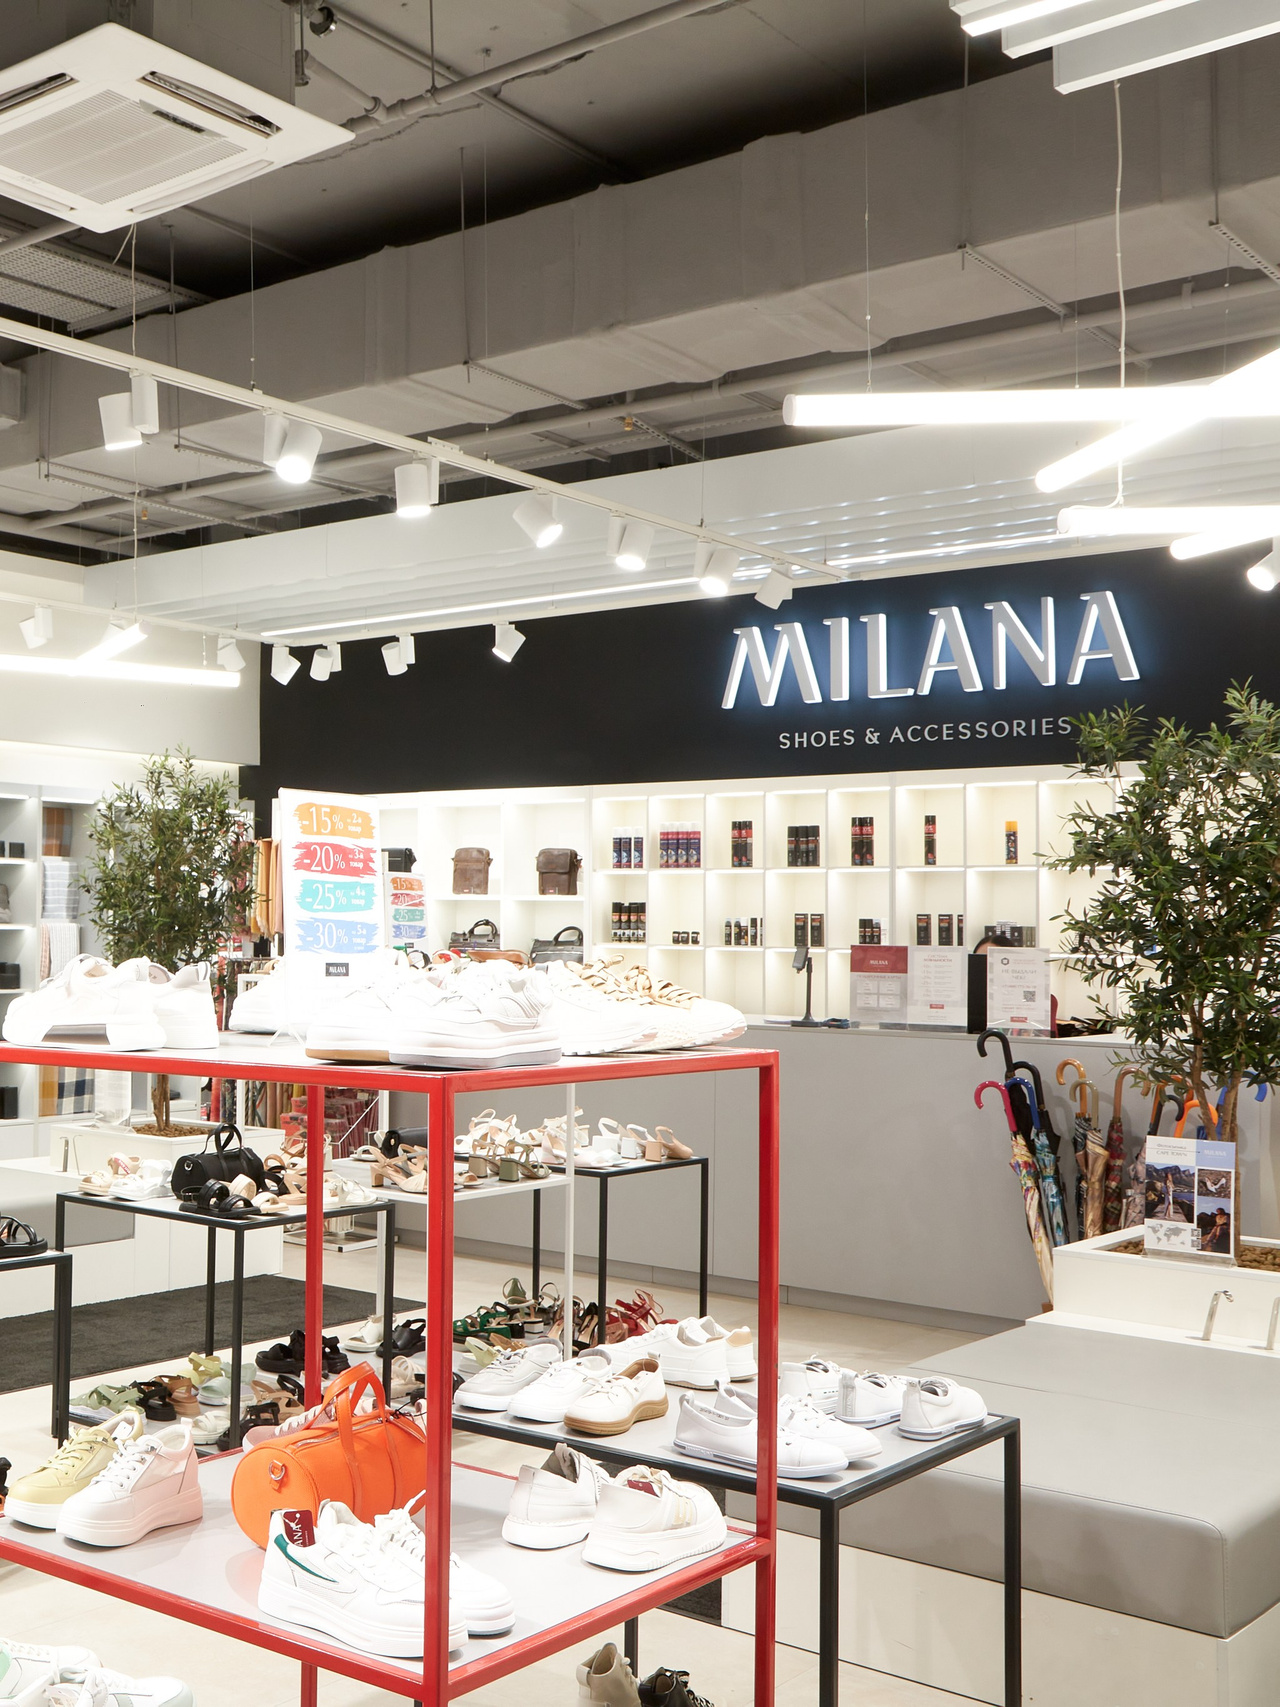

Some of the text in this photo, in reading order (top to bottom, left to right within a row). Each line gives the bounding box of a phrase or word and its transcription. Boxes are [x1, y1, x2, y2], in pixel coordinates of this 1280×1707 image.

[721, 590, 1141, 709] MILANA
[779, 716, 1072, 749] SHOES & ACCESSORIES
[302, 806, 344, 833] -15%
[303, 845, 345, 871] -20%
[305, 883, 347, 910] -25%
[306, 922, 348, 948] -30%
[328, 966, 346, 974] MILANA
